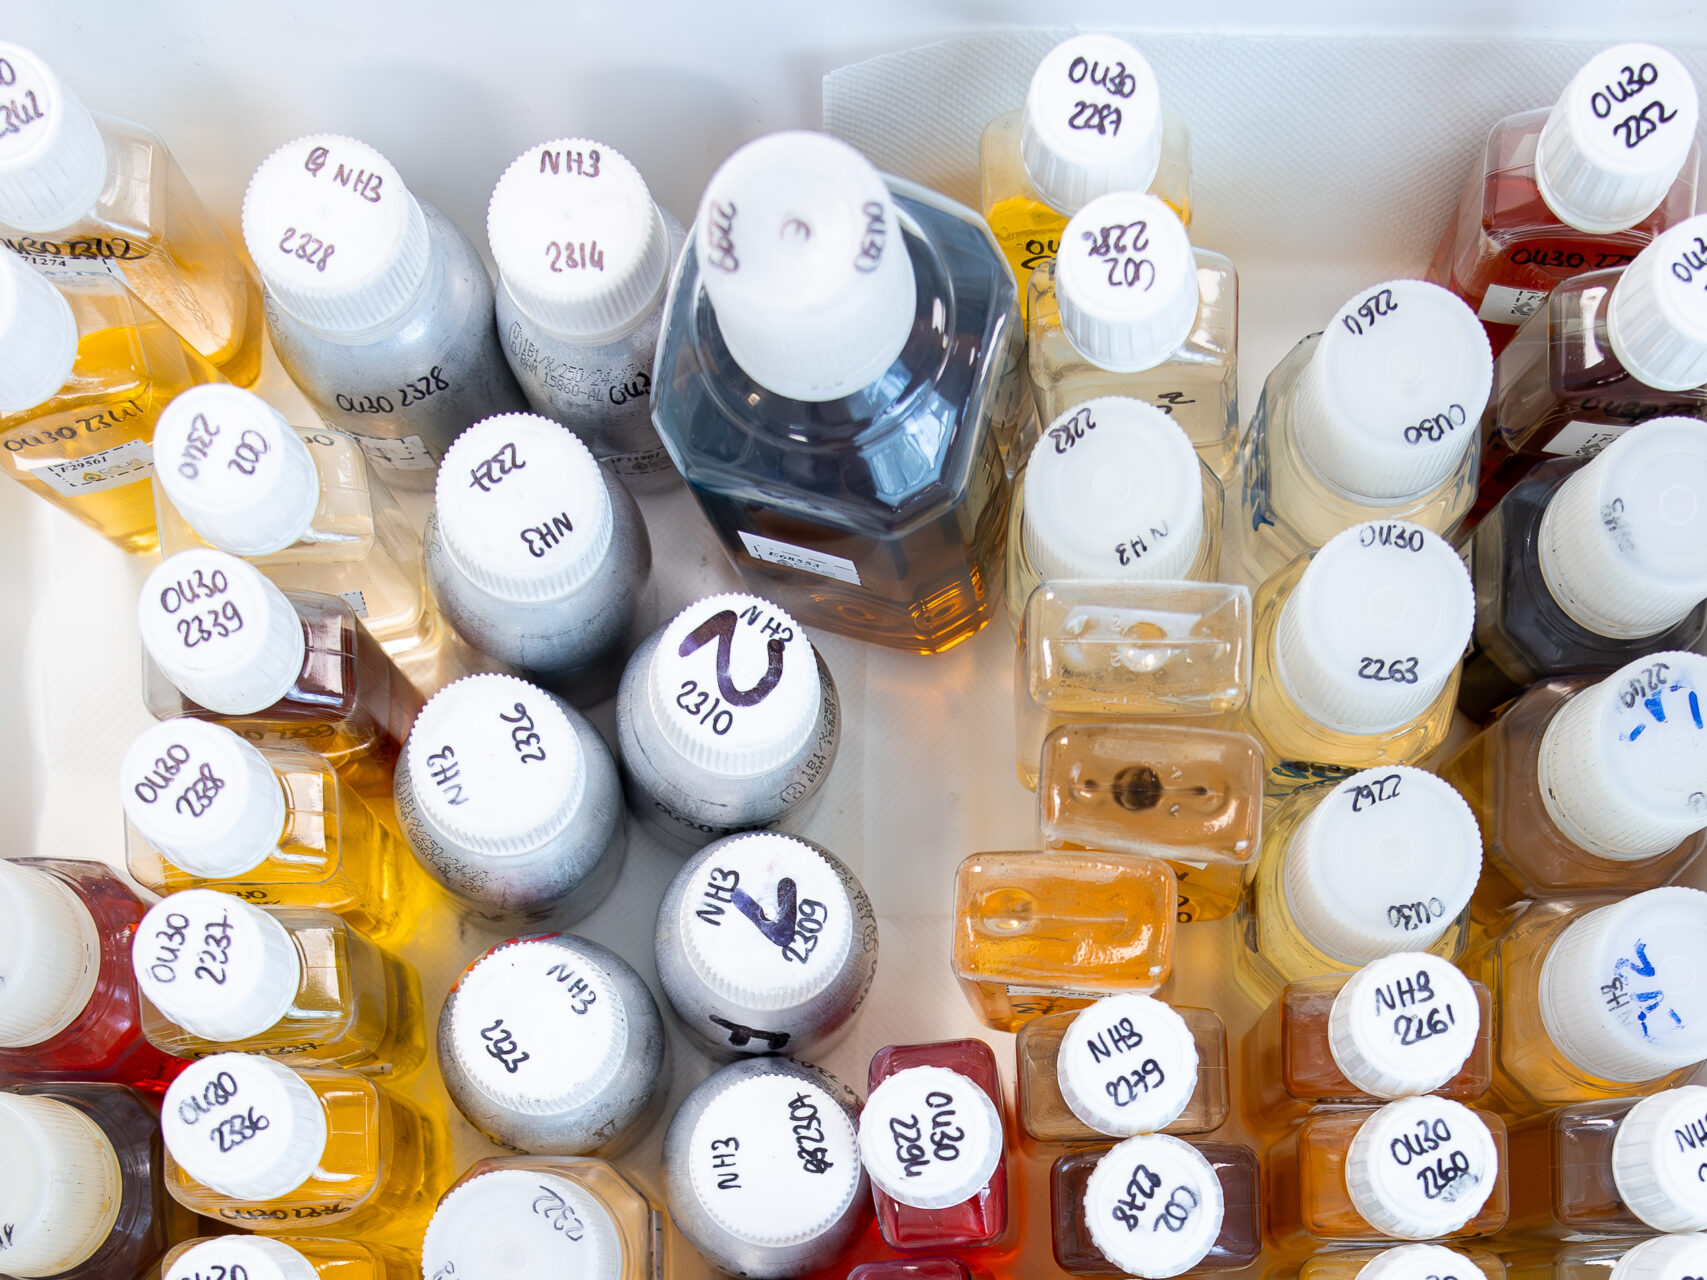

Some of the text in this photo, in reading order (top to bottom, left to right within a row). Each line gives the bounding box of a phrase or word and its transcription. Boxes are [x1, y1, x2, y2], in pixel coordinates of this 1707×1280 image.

[333, 164, 382, 203] NH3
[279, 227, 334, 272] 2328
[177, 600, 243, 648] 2339
[1358, 657, 1419, 684] 2263
[676, 680, 733, 735] 2310
